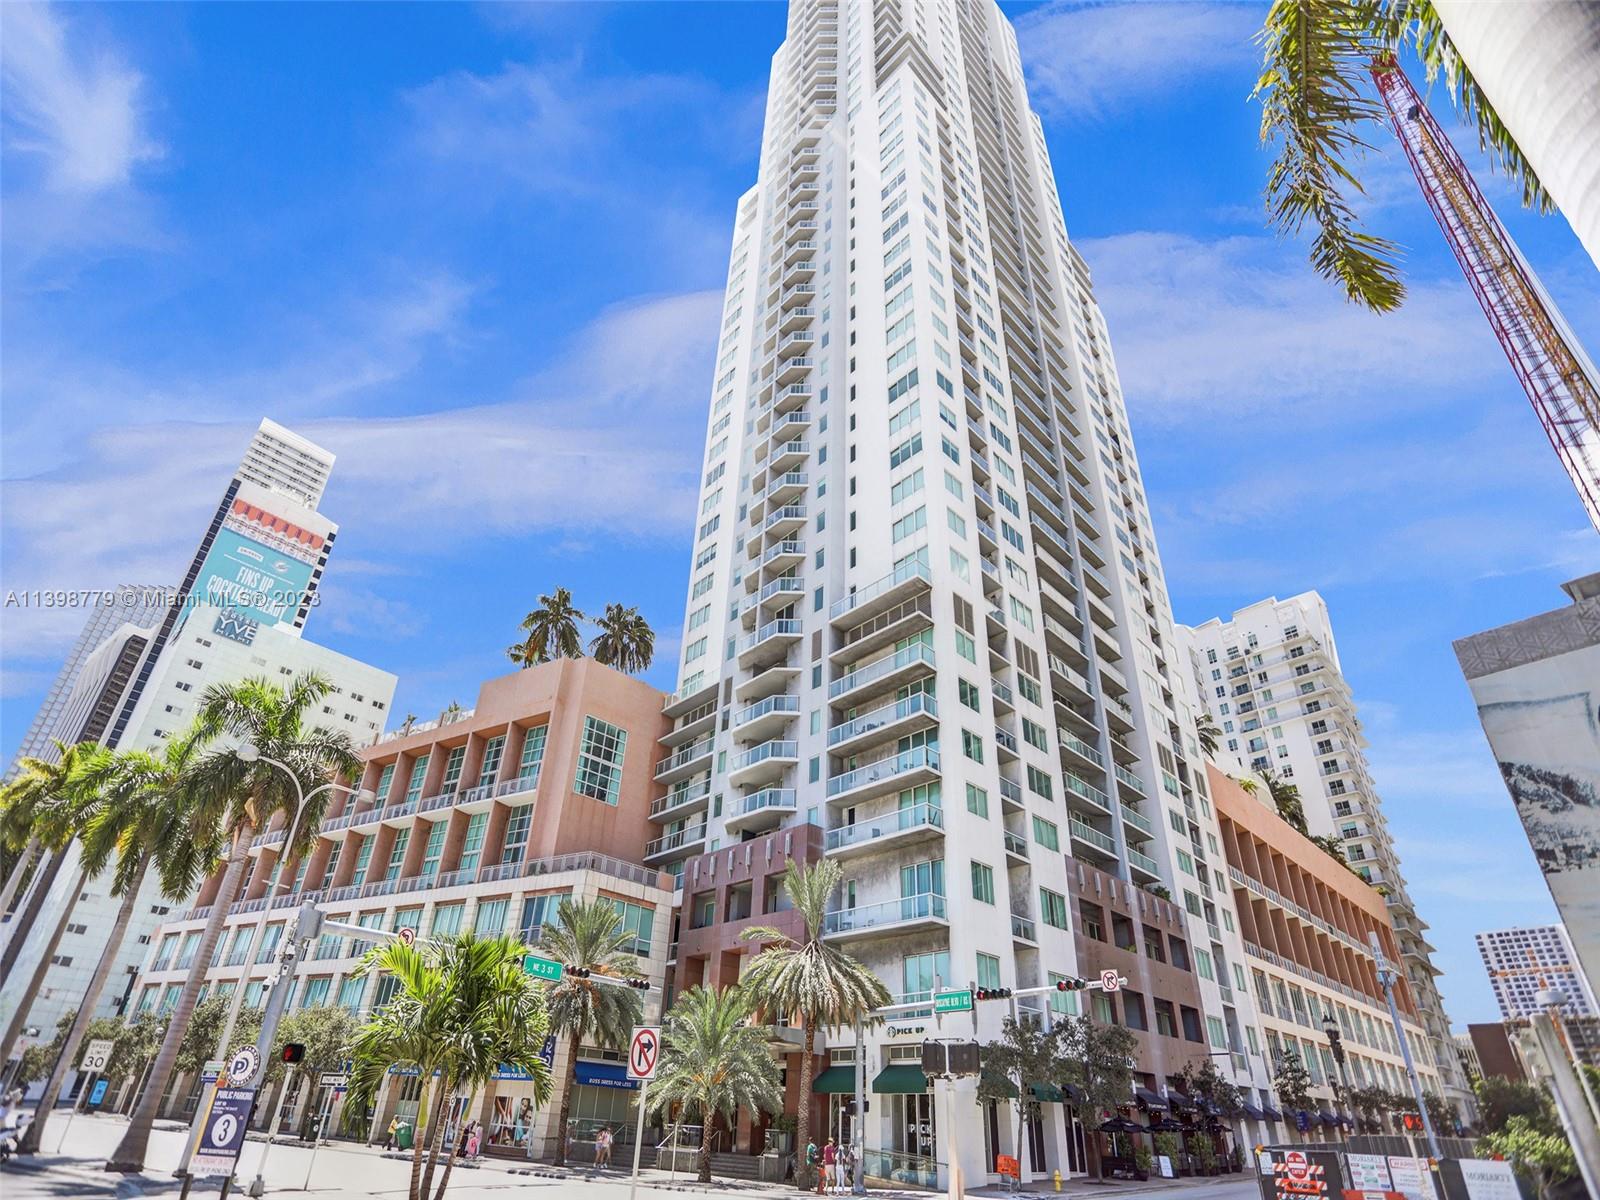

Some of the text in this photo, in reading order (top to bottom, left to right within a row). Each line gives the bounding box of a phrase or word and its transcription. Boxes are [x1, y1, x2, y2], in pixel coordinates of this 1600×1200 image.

[236, 566, 274, 592] FINS UP
[219, 615, 257, 640] YVE
[215, 628, 250, 645] MIAMI
[533, 962, 554, 975] NE 3 ST
[896, 1026, 925, 1035] PICK UP
[91, 1042, 112, 1050] SPEED
[84, 1055, 105, 1068] 30
[216, 1090, 254, 1100] PUBLIC PARKING
[218, 1118, 231, 1142] 3
